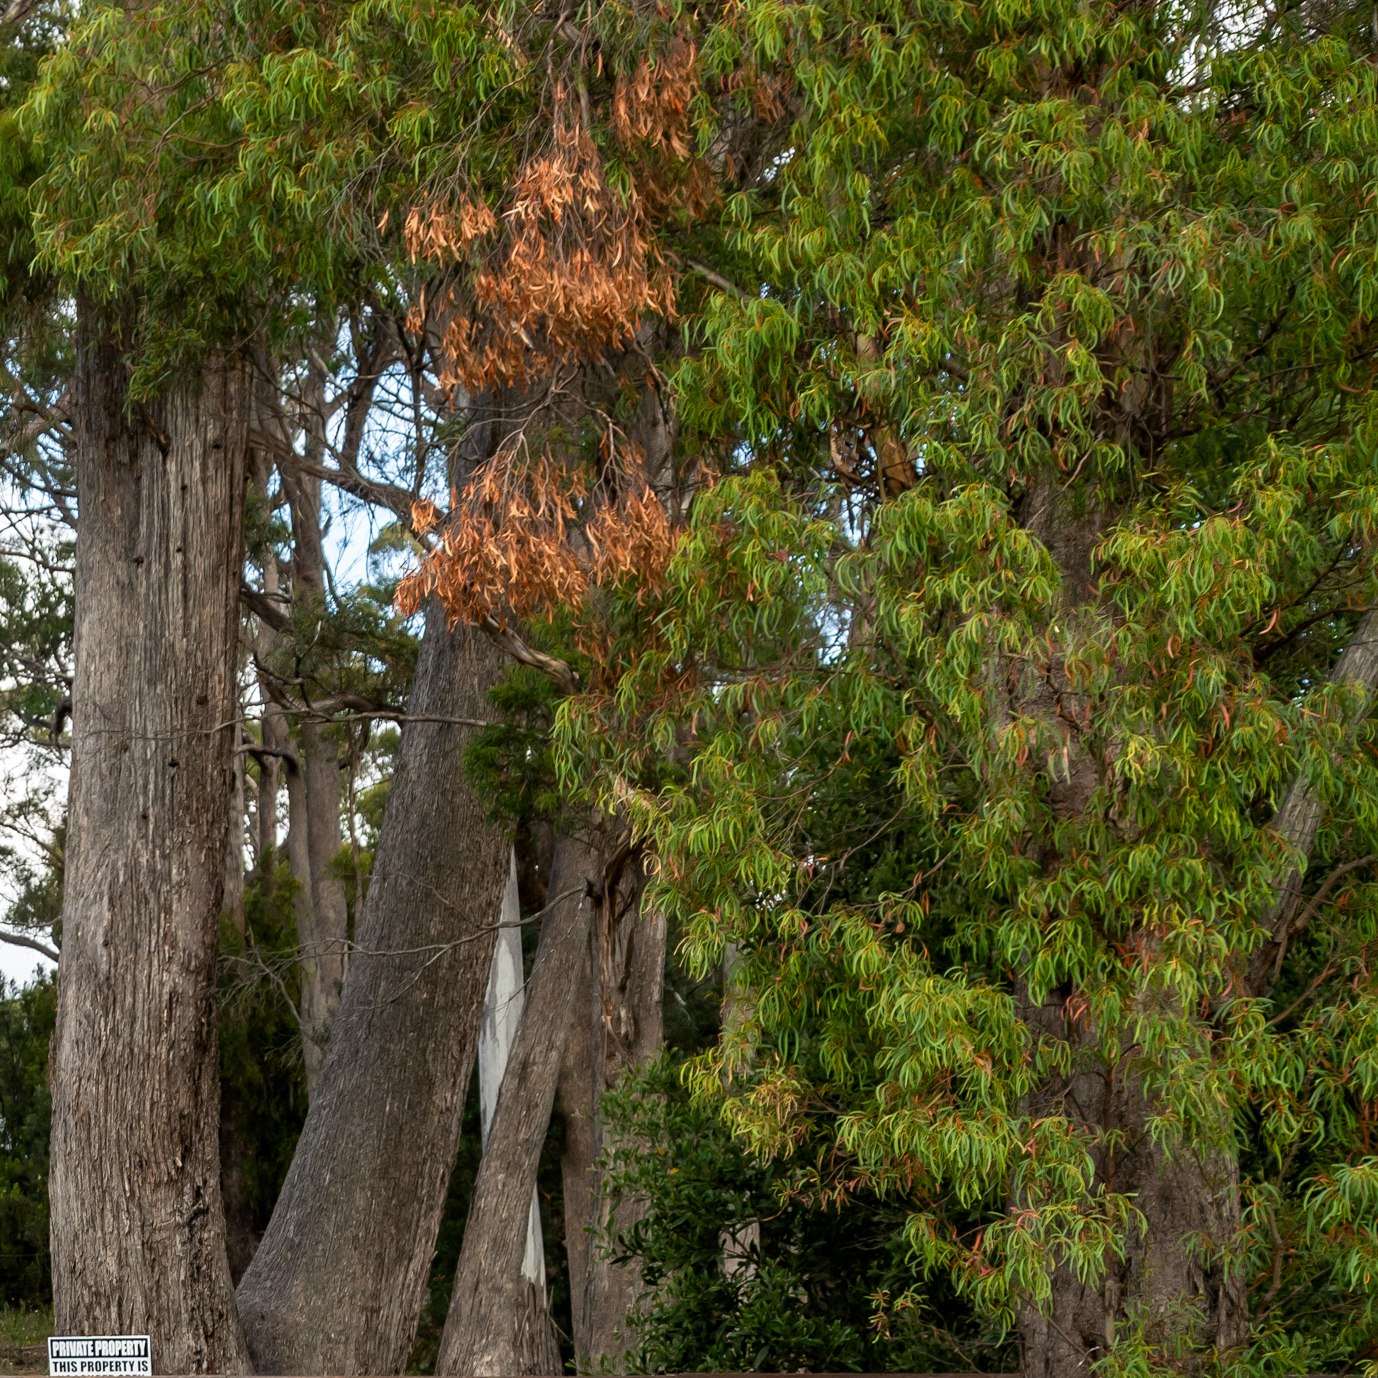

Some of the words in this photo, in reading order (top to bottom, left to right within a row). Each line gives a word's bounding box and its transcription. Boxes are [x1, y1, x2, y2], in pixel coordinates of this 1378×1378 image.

[52, 1341, 94, 1357] PRIVATE
[94, 1340, 146, 1356] PROPERTY
[53, 1361, 77, 1372] THIS
[81, 1360, 135, 1372] PROPERTY
[138, 1360, 148, 1372] IS
